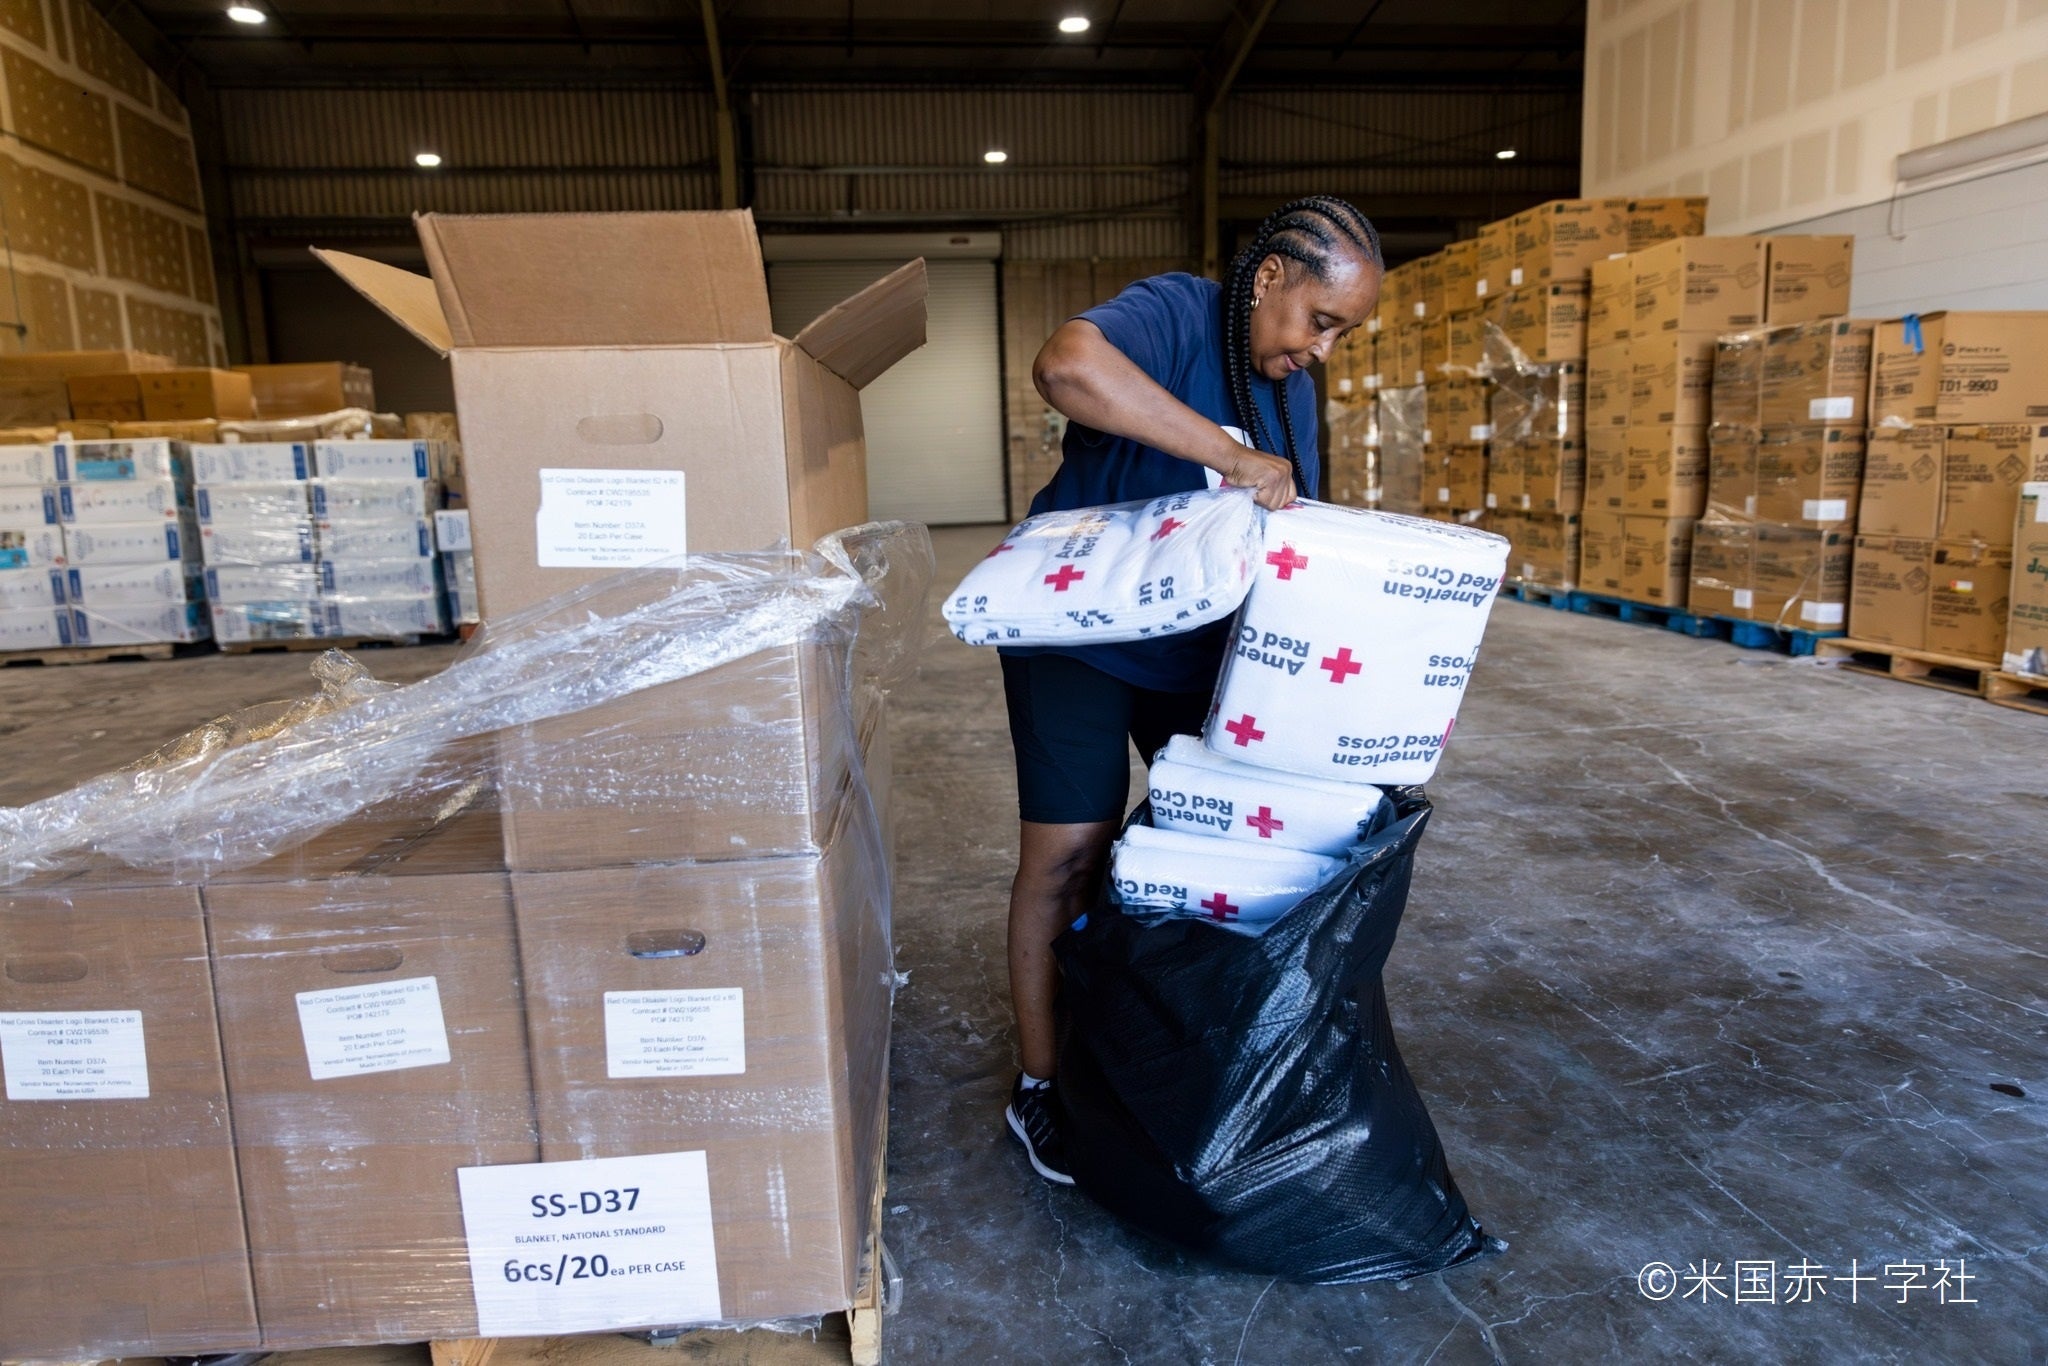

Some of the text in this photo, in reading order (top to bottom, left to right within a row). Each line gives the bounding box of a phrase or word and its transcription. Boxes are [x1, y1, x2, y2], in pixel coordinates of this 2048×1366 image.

[574, 521, 590, 529] Item
[1074, 536, 1101, 558] Red
[1457, 571, 1498, 592] Red
[1383, 580, 1487, 608] American
[1262, 632, 1311, 658] Red
[1337, 733, 1444, 751] Red Cross
[1332, 748, 1437, 768] American
[1191, 794, 1234, 816] Red
[1144, 881, 1188, 899] Red
[315, 996, 334, 1004] Cross
[335, 994, 362, 1002] Disaster
[363, 991, 380, 999] Logo
[381, 988, 405, 996] Blanket
[622, 997, 641, 1005] Cross
[326, 1004, 356, 1014] Contract
[16, 1017, 35, 1025] Cross
[37, 1017, 64, 1025] Disaster
[66, 1017, 83, 1026] Logo
[338, 1034, 355, 1042] Item
[343, 1044, 353, 1052] 20
[354, 1041, 373, 1050] Each
[640, 1036, 655, 1044] Item
[653, 1045, 671, 1053] Each
[531, 1187, 641, 1218] SS-D37
[514, 1224, 666, 1245] BLANKET, NATIONAL STANDARD
[628, 1263, 653, 1275] PER
[655, 1260, 687, 1273] CASE
